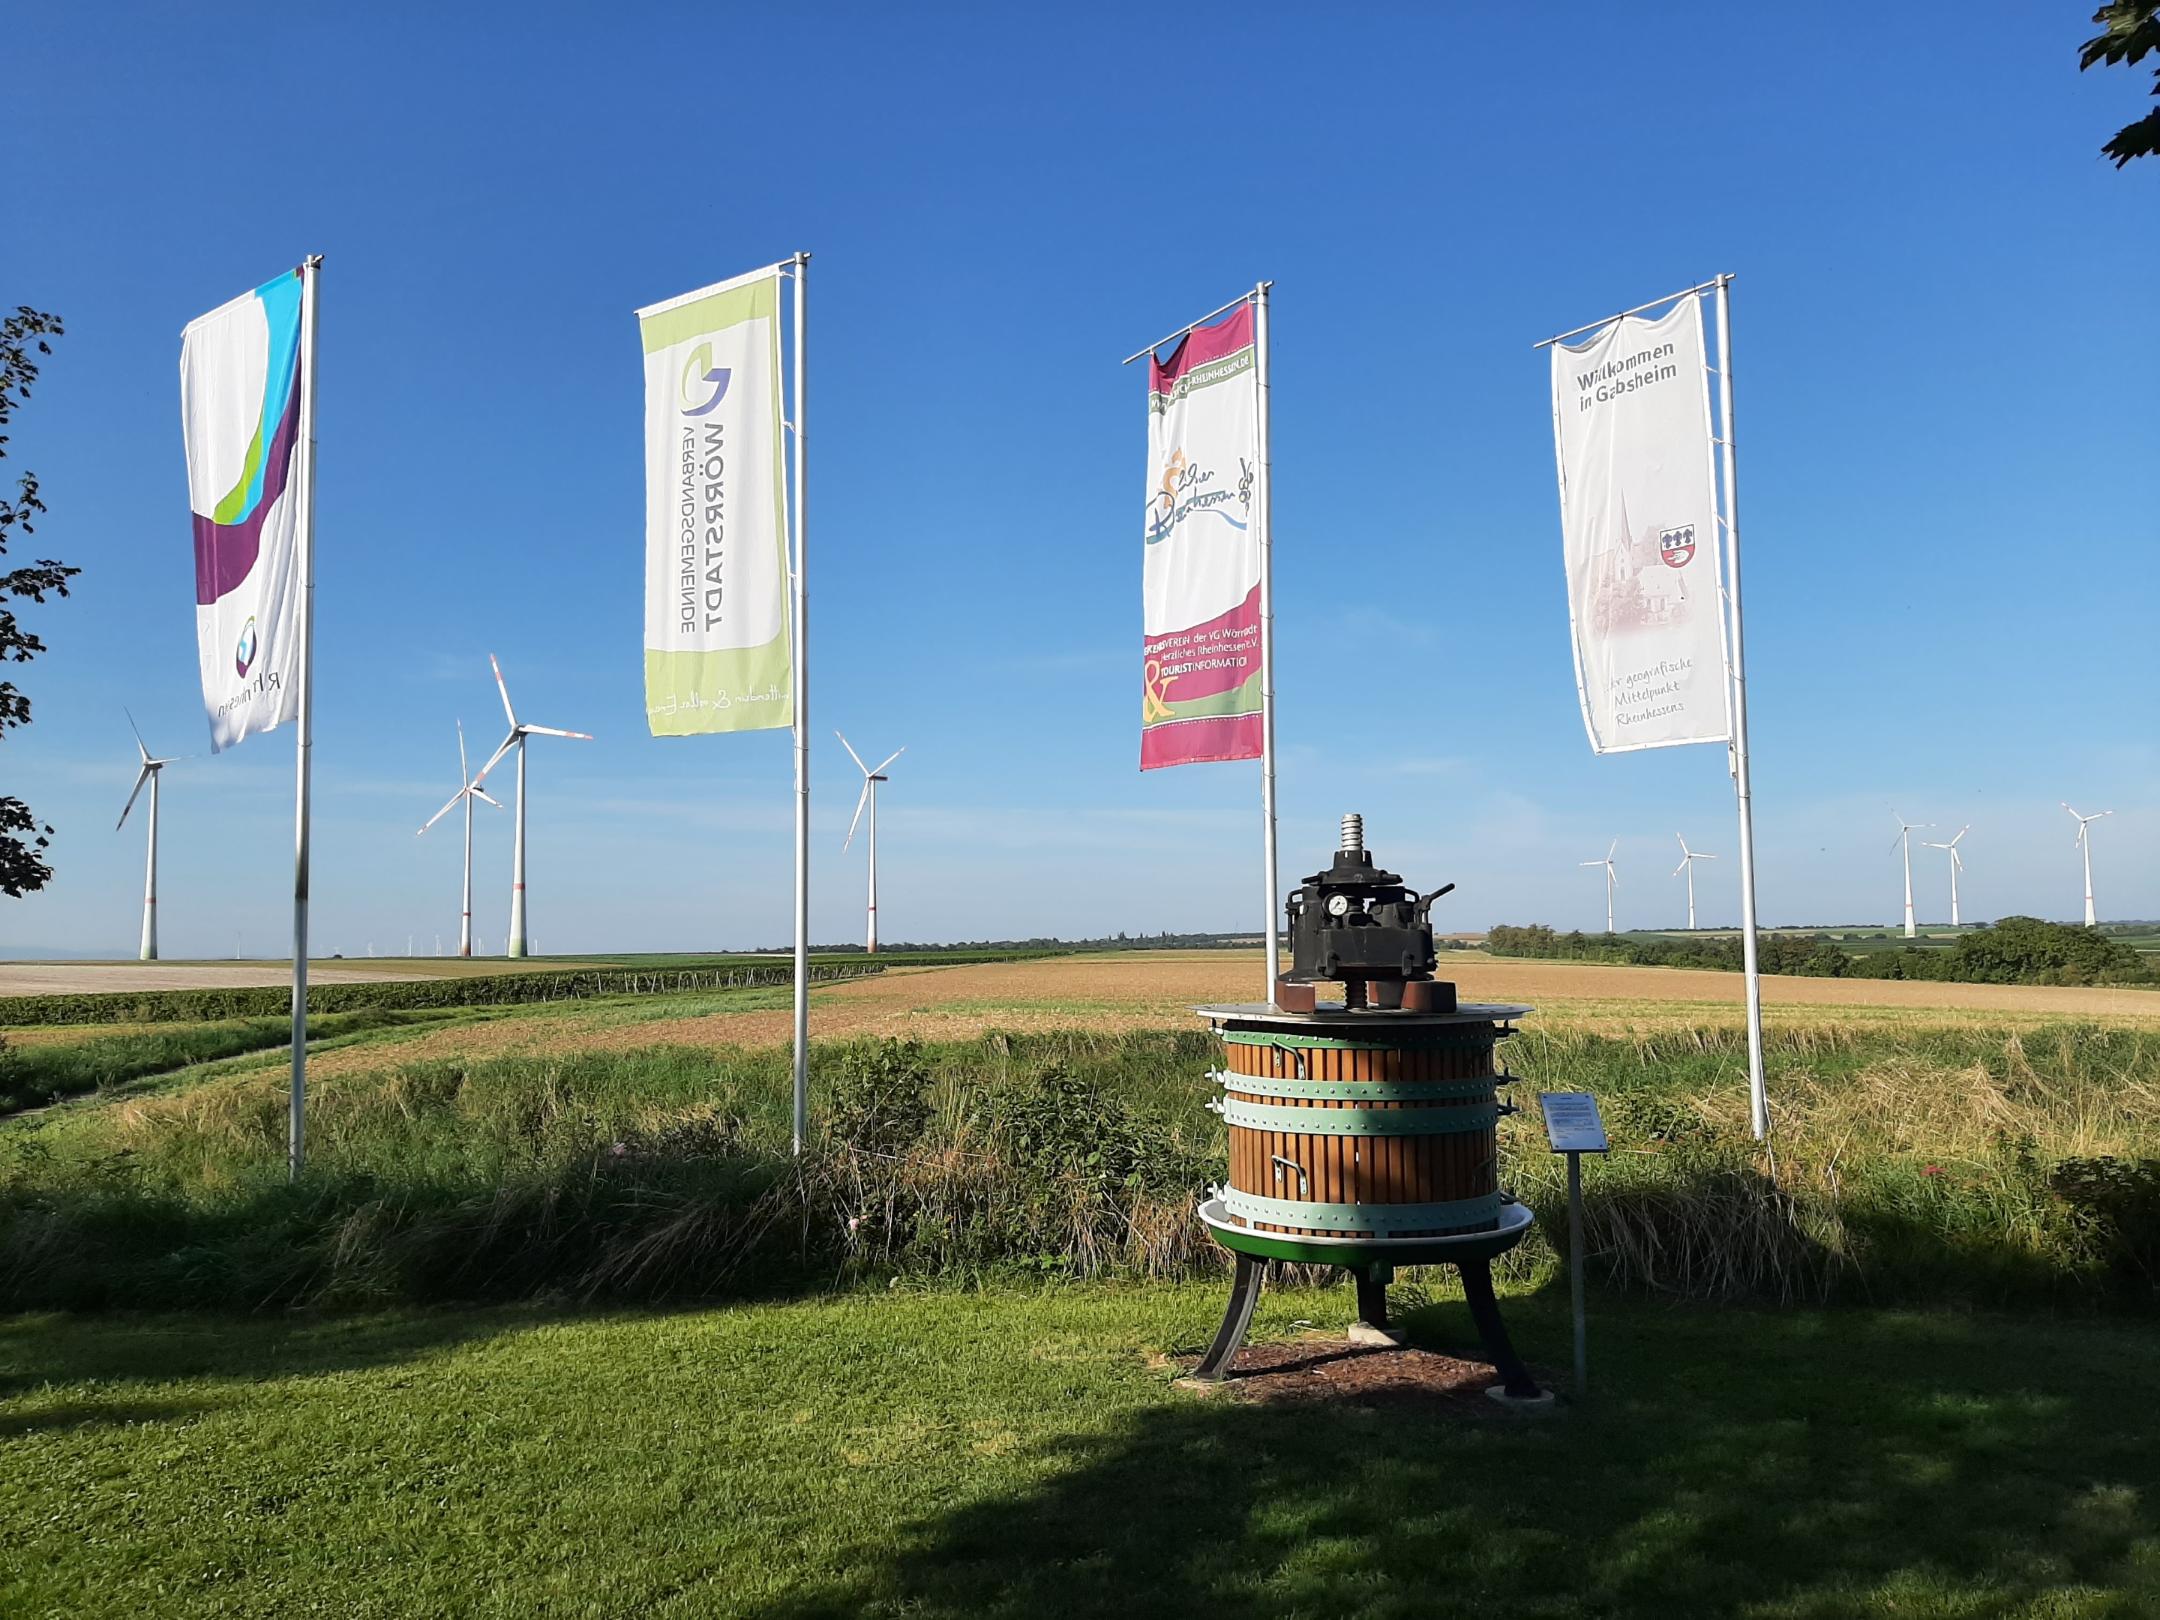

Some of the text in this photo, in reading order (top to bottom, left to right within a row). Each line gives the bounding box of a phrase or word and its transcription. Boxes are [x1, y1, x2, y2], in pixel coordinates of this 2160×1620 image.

[1577, 343, 1674, 391] Willkommen
[1580, 364, 1676, 412] in Gabsheim
[1193, 632, 1207, 643] der
[1209, 630, 1220, 641] VG
[1161, 656, 1248, 678] TOURISTINFORMATIO
[1615, 680, 1680, 705] Mittelpunkt
[1616, 703, 1685, 728] Rheinhessens
